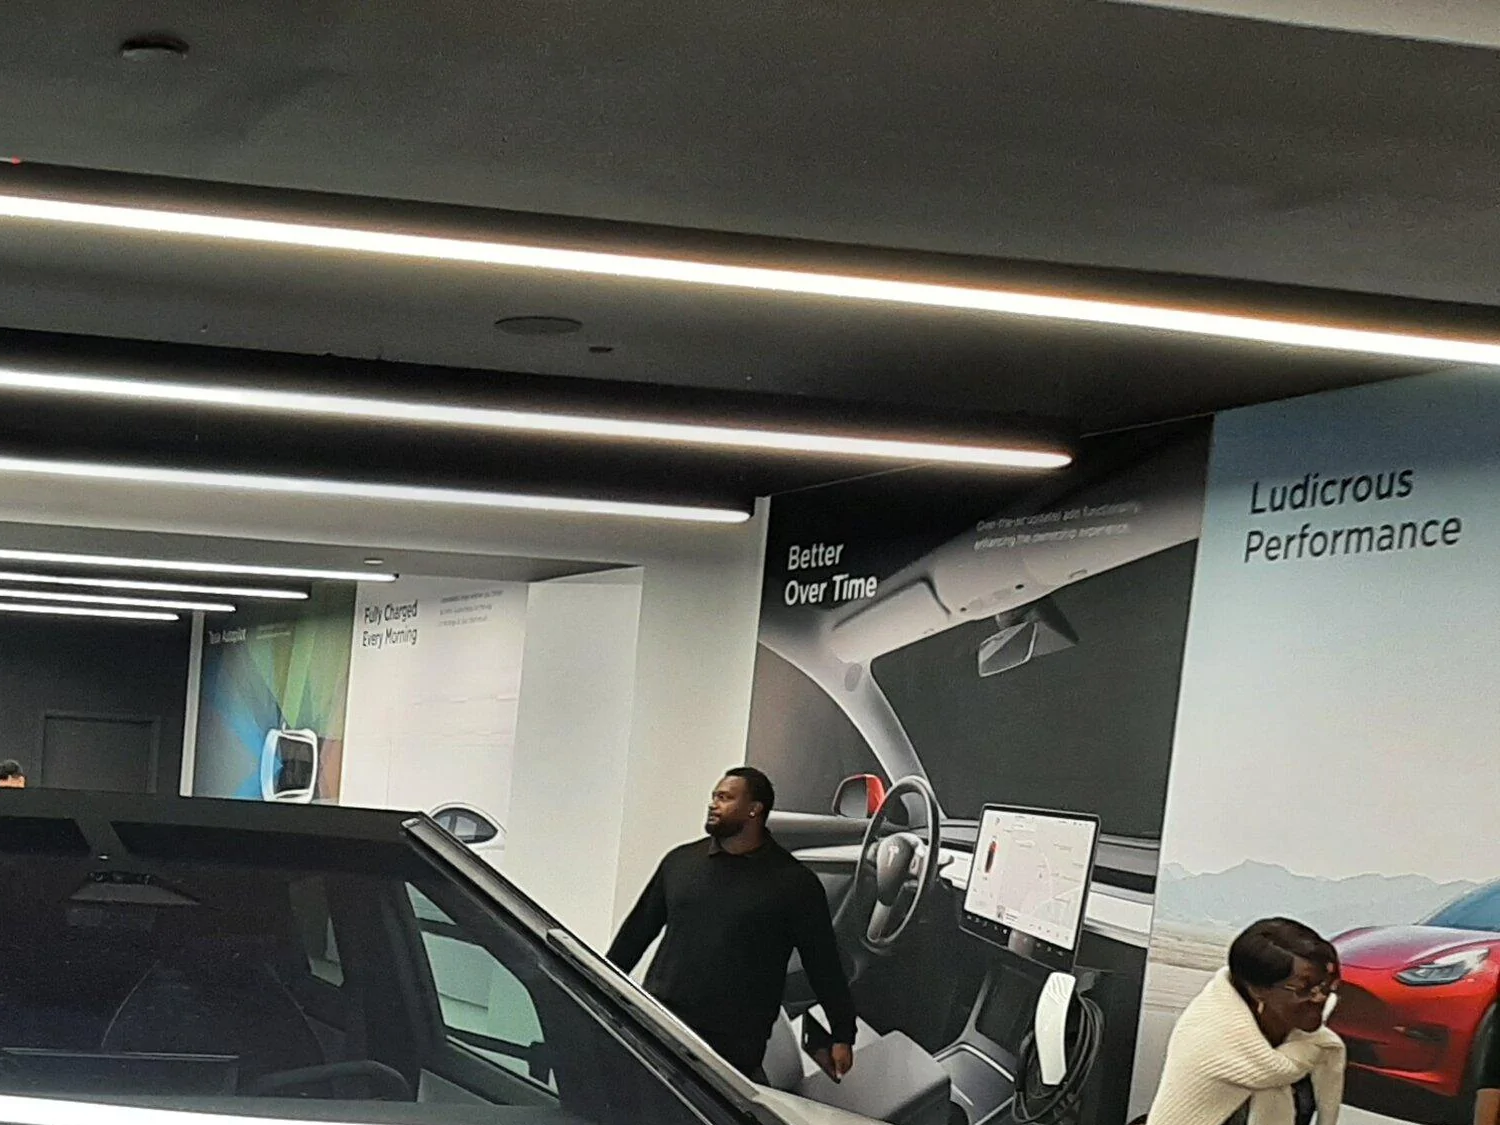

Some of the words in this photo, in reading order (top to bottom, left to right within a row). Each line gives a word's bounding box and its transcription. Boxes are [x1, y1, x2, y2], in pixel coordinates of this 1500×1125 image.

[1250, 469, 1414, 514] Ludicrous
[1244, 516, 1462, 563] Performance
[787, 543, 844, 571] Better
[784, 580, 828, 606] Over
[832, 573, 878, 601] Time
[364, 605, 382, 625] Fully
[384, 600, 419, 623] Charged
[362, 630, 383, 649] Every
[385, 625, 418, 645] Morning
